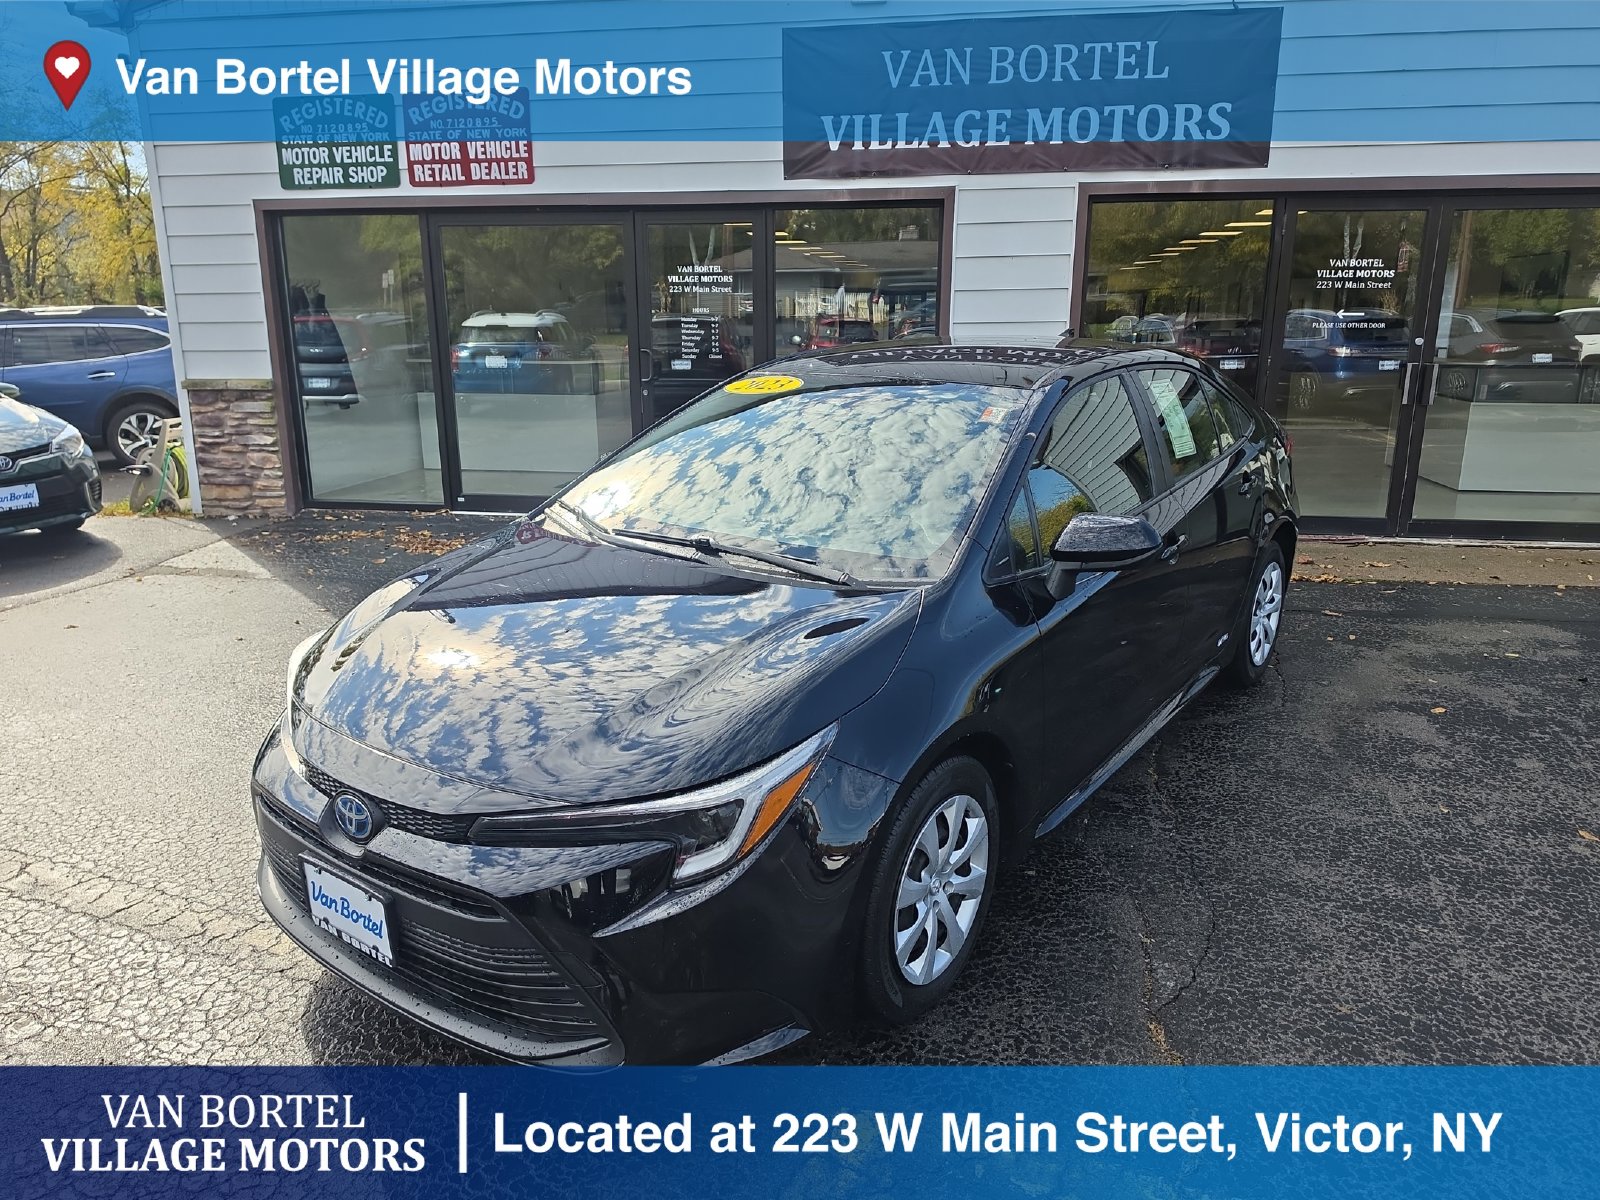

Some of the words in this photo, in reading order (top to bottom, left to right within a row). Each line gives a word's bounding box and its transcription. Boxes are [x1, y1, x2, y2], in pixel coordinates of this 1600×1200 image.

[882, 47, 973, 89] VAN
[987, 40, 1169, 84] BORTEL
[280, 98, 389, 132] REGISTERED
[317, 122, 369, 133] 7120895
[446, 116, 498, 129] 7120895
[820, 109, 1012, 151] VILLAGE
[1025, 102, 1233, 145] MOTORS
[281, 134, 312, 144] STATE
[315, 134, 329, 144] OF
[332, 133, 357, 143] NEW
[360, 131, 391, 142] YORK
[408, 130, 443, 140] STATE
[448, 129, 462, 139] OF
[467, 128, 491, 139] NEW
[495, 127, 528, 138] YORK
[282, 147, 331, 166] MOTOR
[332, 144, 394, 163] VEHICLE
[409, 142, 462, 161] MOTOR
[466, 139, 529, 158] VEHICLE
[293, 167, 344, 185] REPAIR
[348, 165, 388, 183] SHOP
[413, 163, 466, 182] RETAIL
[471, 161, 528, 180] DEALER
[677, 265, 693, 273] VAN
[694, 265, 723, 273] BORTEL
[1329, 258, 1348, 268] VAN
[1349, 258, 1385, 268] BORTEL
[667, 275, 700, 283] VILLAGE
[700, 275, 733, 283] MOTORS
[1316, 269, 1355, 278] VILLAGE
[1356, 269, 1396, 278] MOTORS
[669, 285, 683, 293] 223
[684, 285, 692, 293] W
[693, 285, 710, 293] Main
[711, 285, 732, 293] Street
[1316, 280, 1333, 289] 223
[1334, 280, 1343, 289] W
[1344, 280, 1366, 289] Main
[1366, 280, 1392, 289] Street
[311, 881, 339, 913] Van
[340, 897, 384, 939] Bortel
